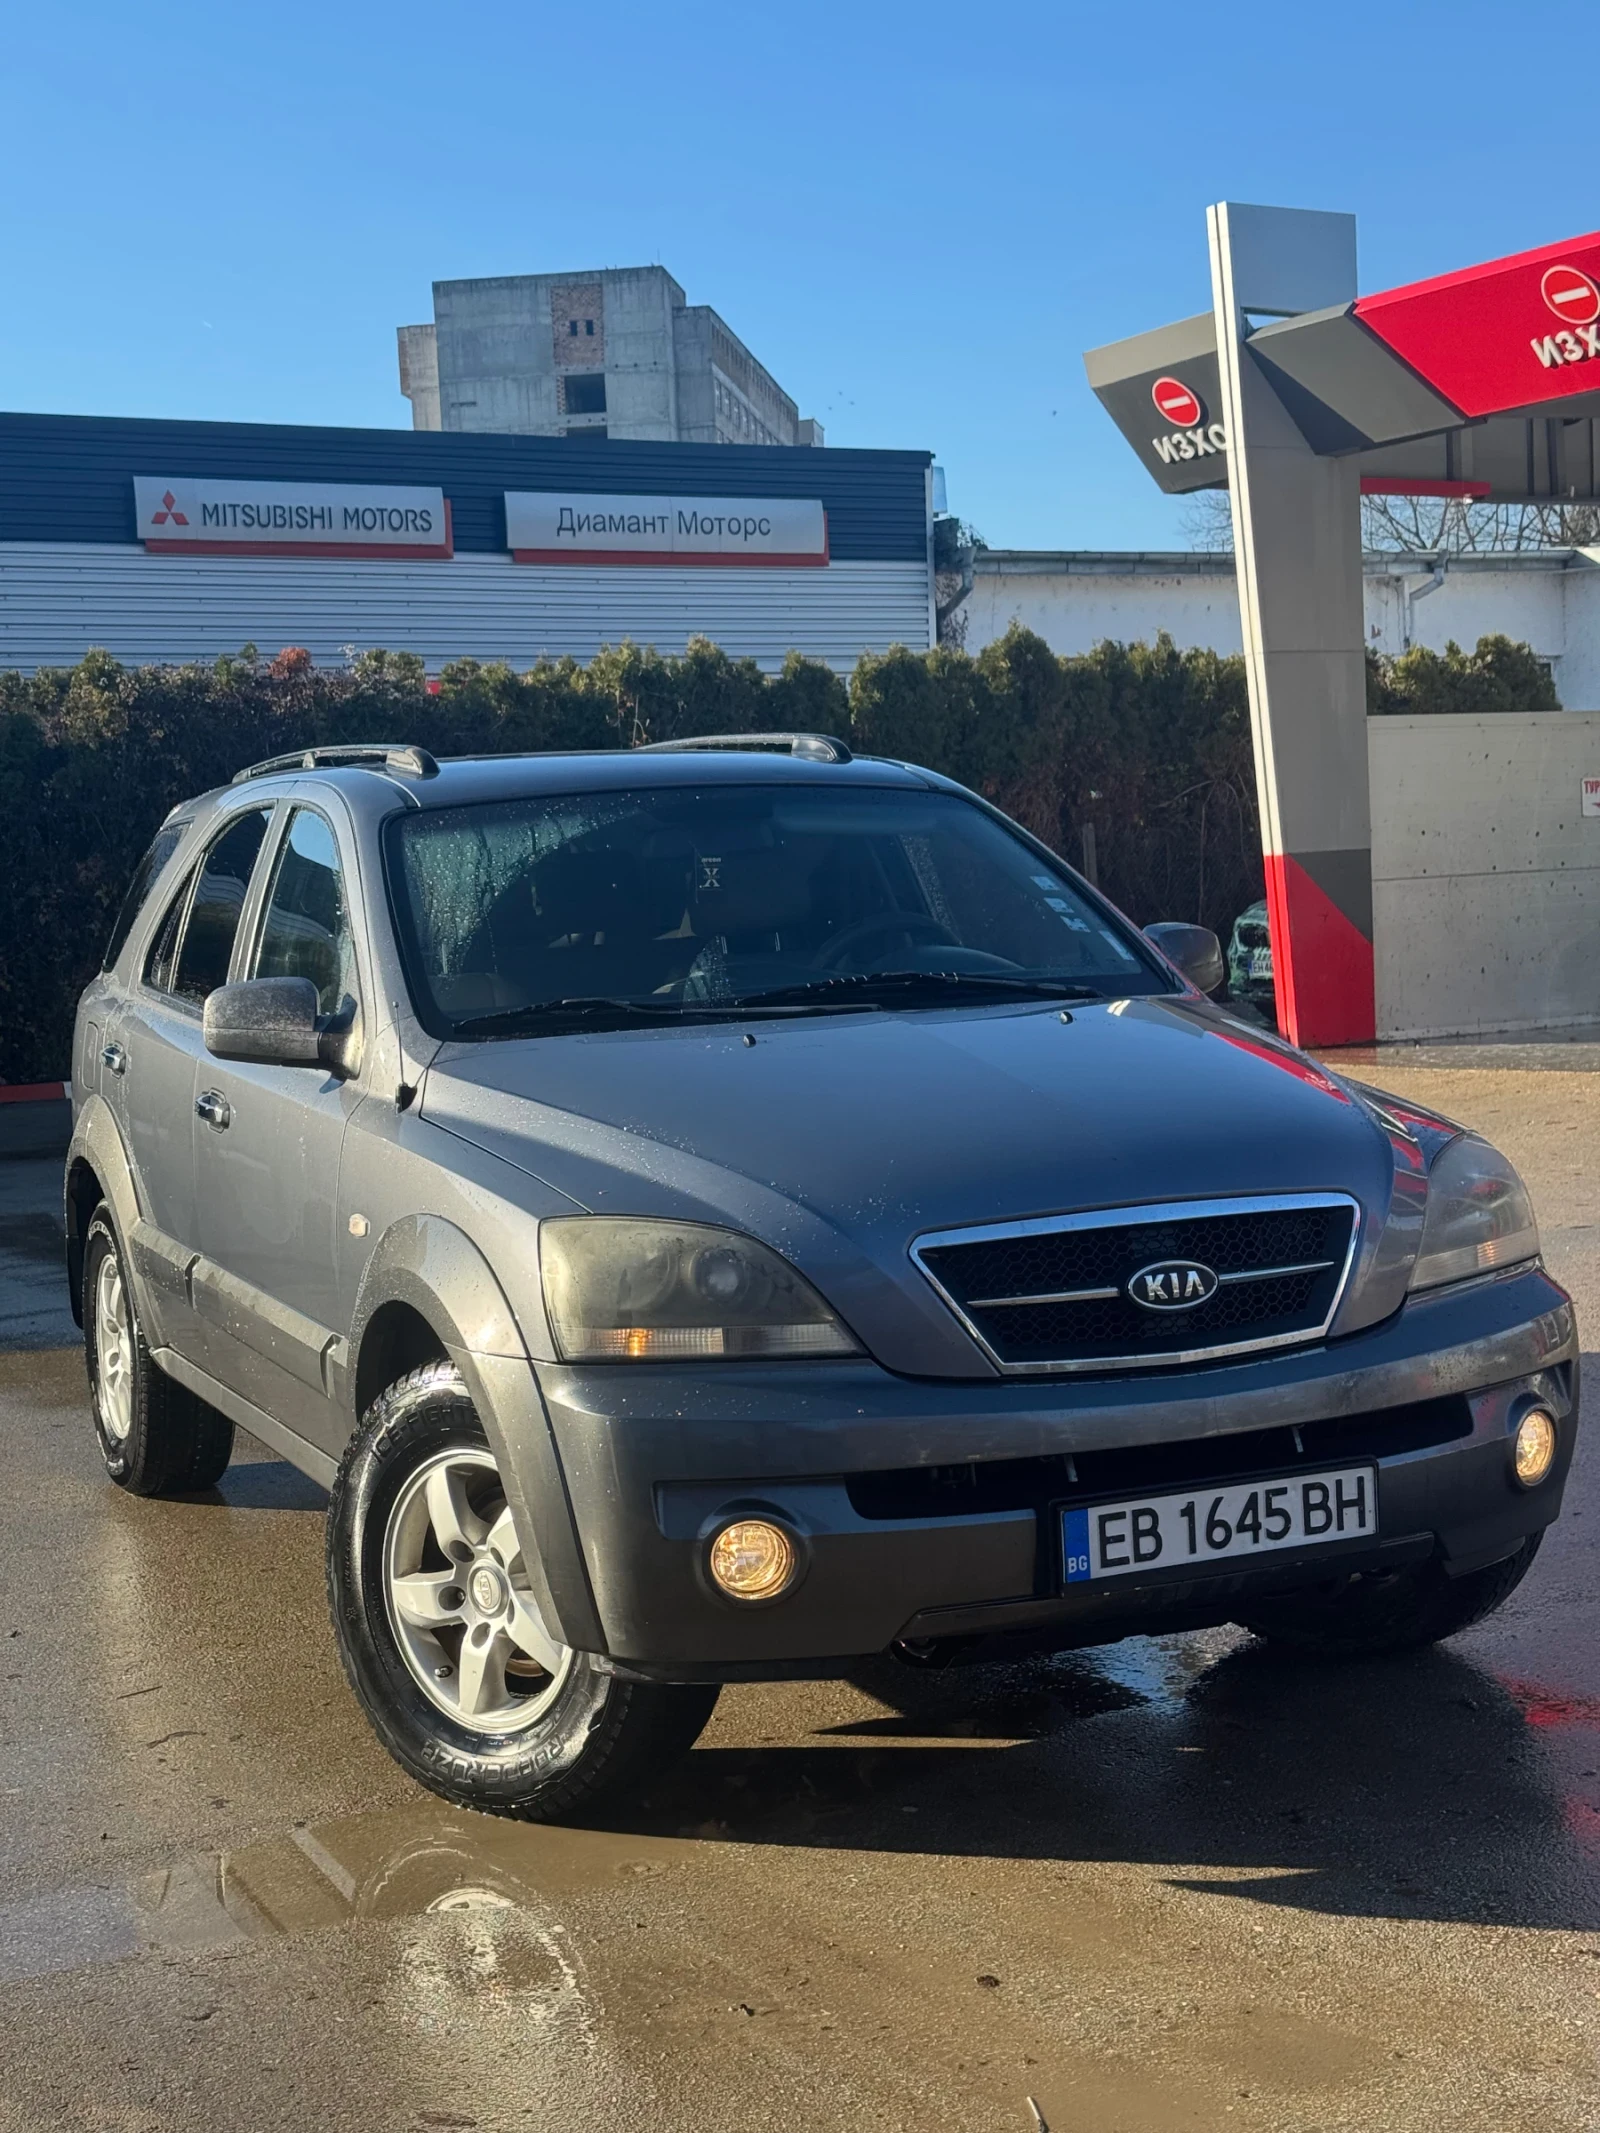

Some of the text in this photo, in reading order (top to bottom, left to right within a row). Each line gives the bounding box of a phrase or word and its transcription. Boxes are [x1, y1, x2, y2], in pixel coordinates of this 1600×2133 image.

[202, 502, 432, 533] MITSUBISHI MOTORS
[556, 507, 771, 541] Диамант Моторс
[1144, 1270, 1205, 1300] KIA
[1098, 1475, 1366, 1569] EB 1645 BH
[1068, 1555, 1088, 1574] BG
